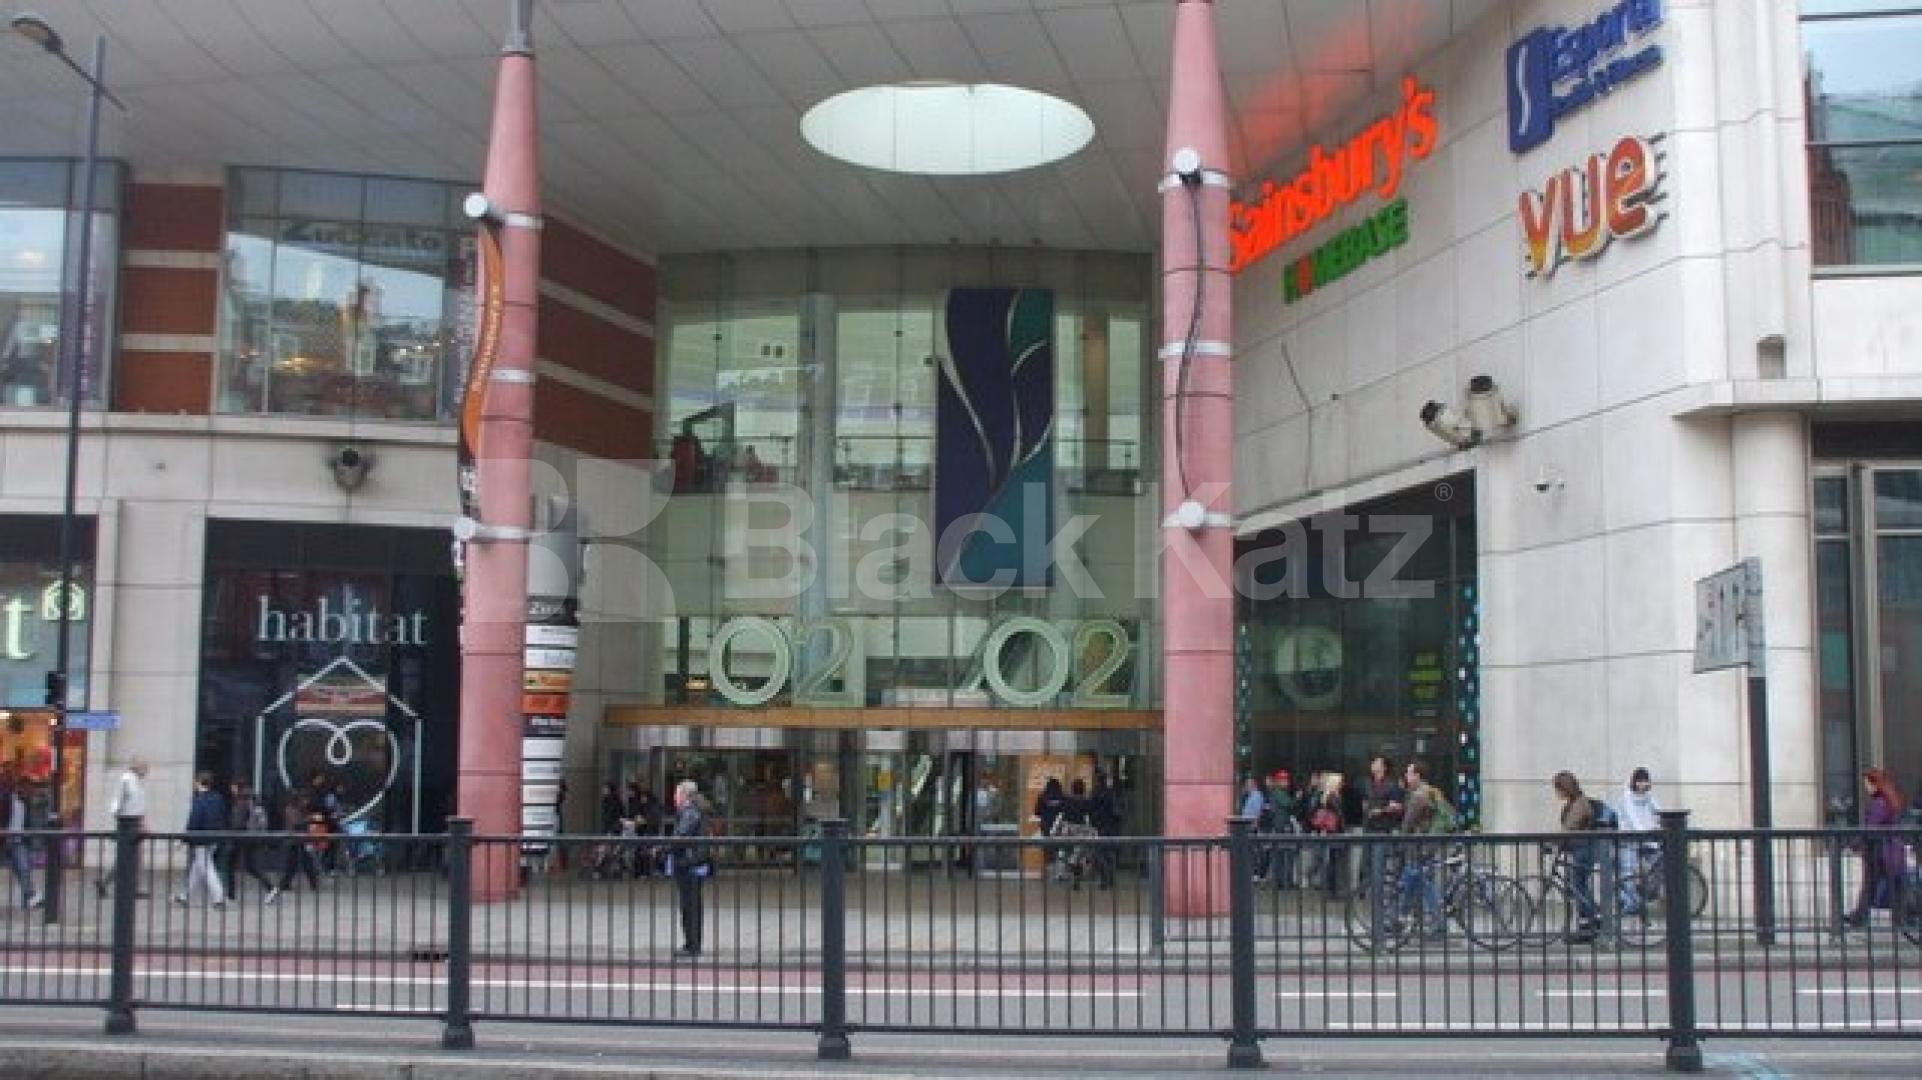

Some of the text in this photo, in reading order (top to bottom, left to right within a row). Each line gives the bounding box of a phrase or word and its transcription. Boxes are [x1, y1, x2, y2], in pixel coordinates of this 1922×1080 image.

[1229, 73, 1438, 274] Sainsbury's
[1283, 196, 1410, 304] HOMEBASE
[258, 595, 427, 645] habitat
